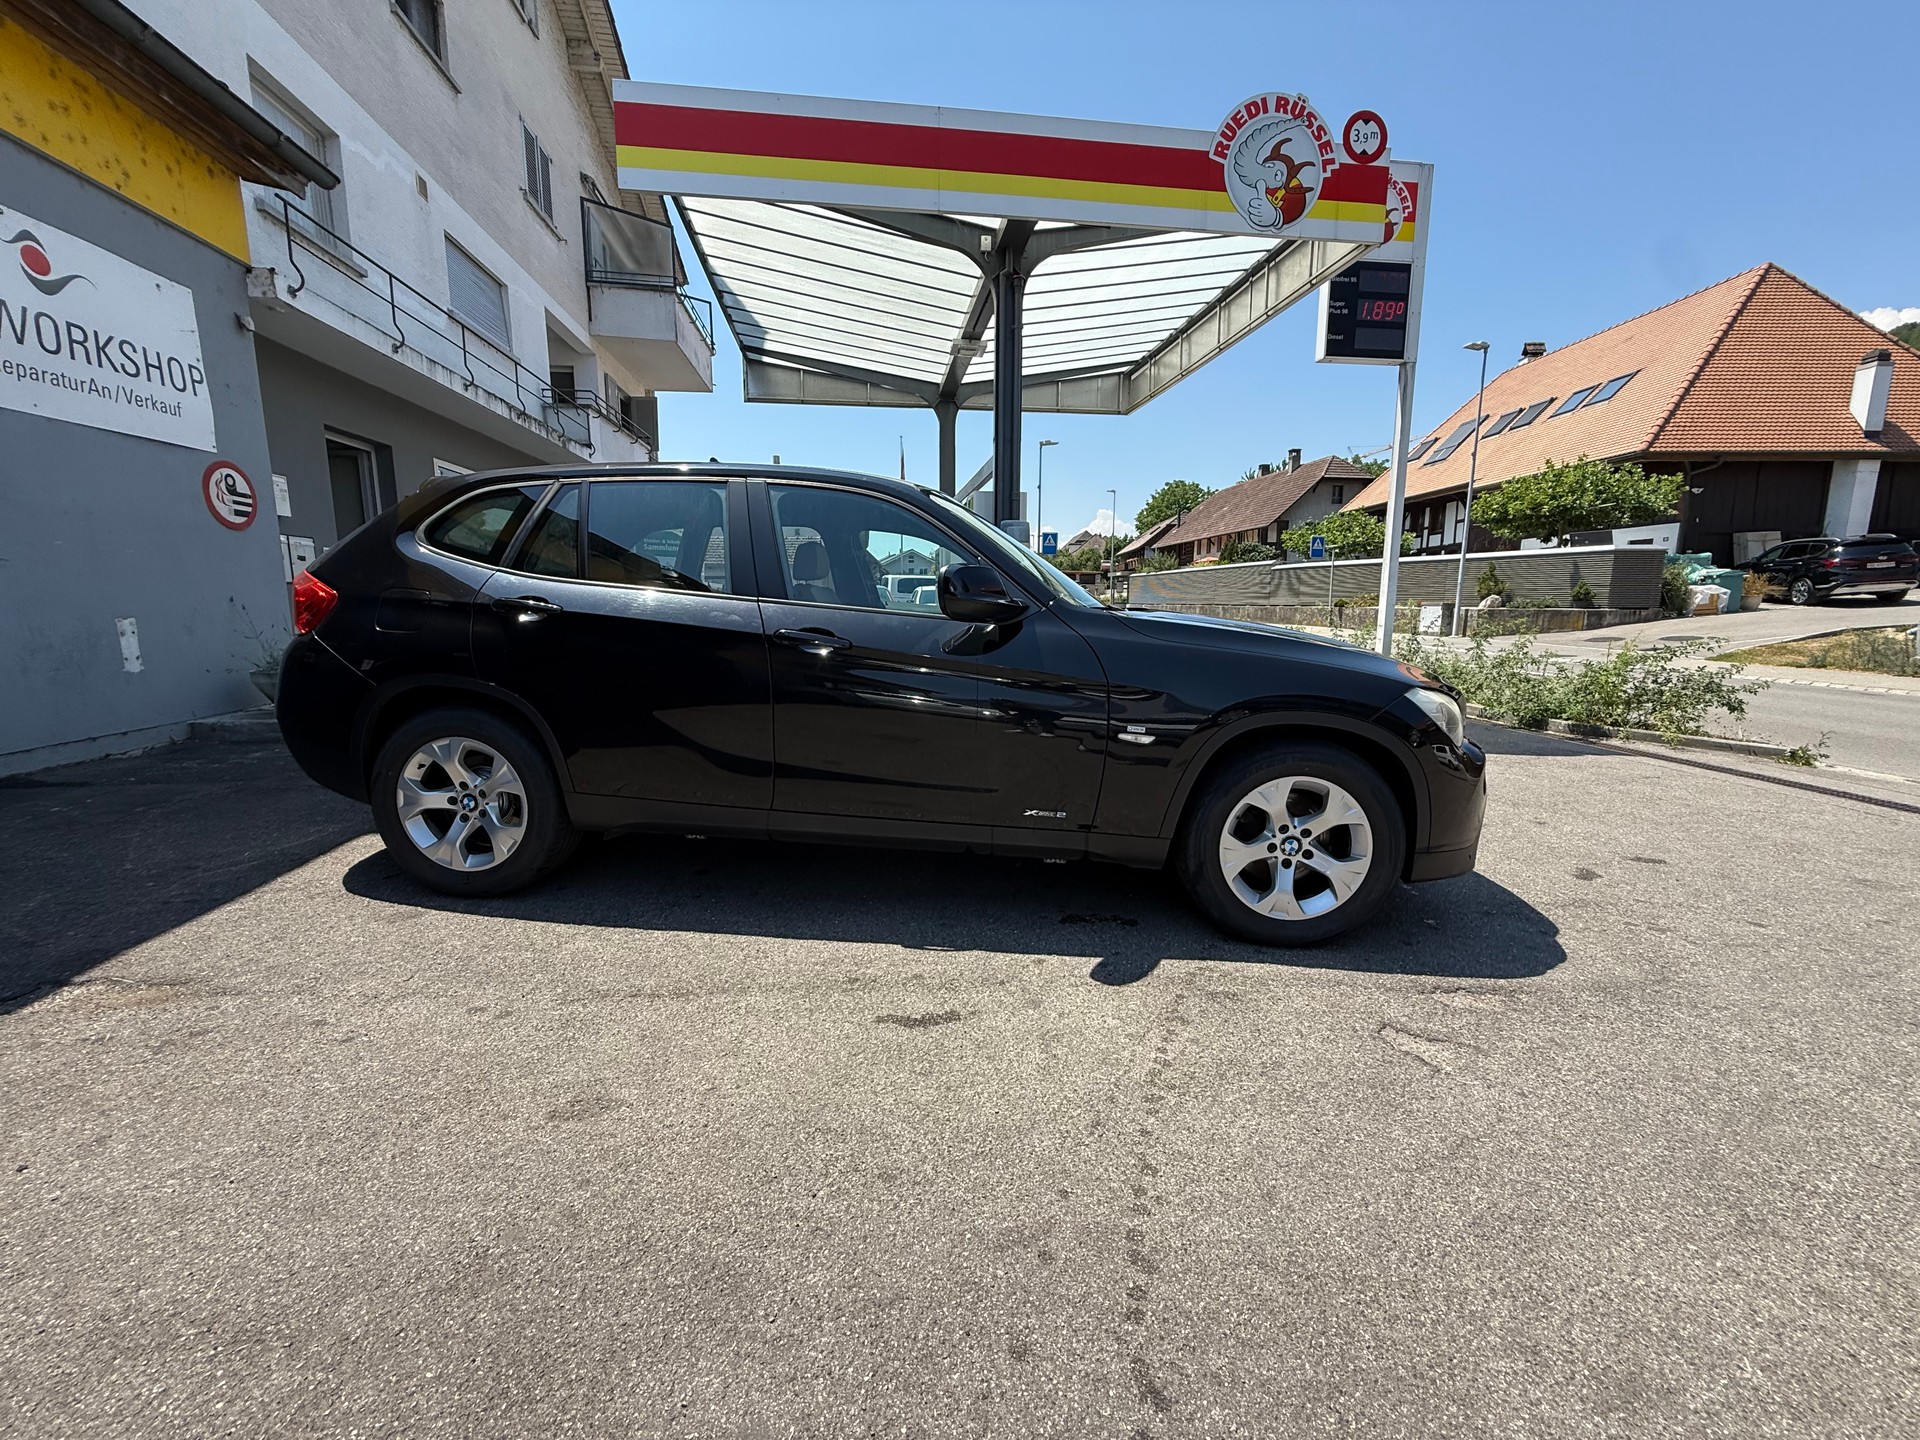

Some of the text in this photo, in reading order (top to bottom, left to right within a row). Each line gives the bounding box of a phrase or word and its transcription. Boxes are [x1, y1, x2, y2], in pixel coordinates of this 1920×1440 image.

[1213, 96, 1335, 173] RUEDI RÜSSEL
[1389, 173, 1411, 215] SSEL
